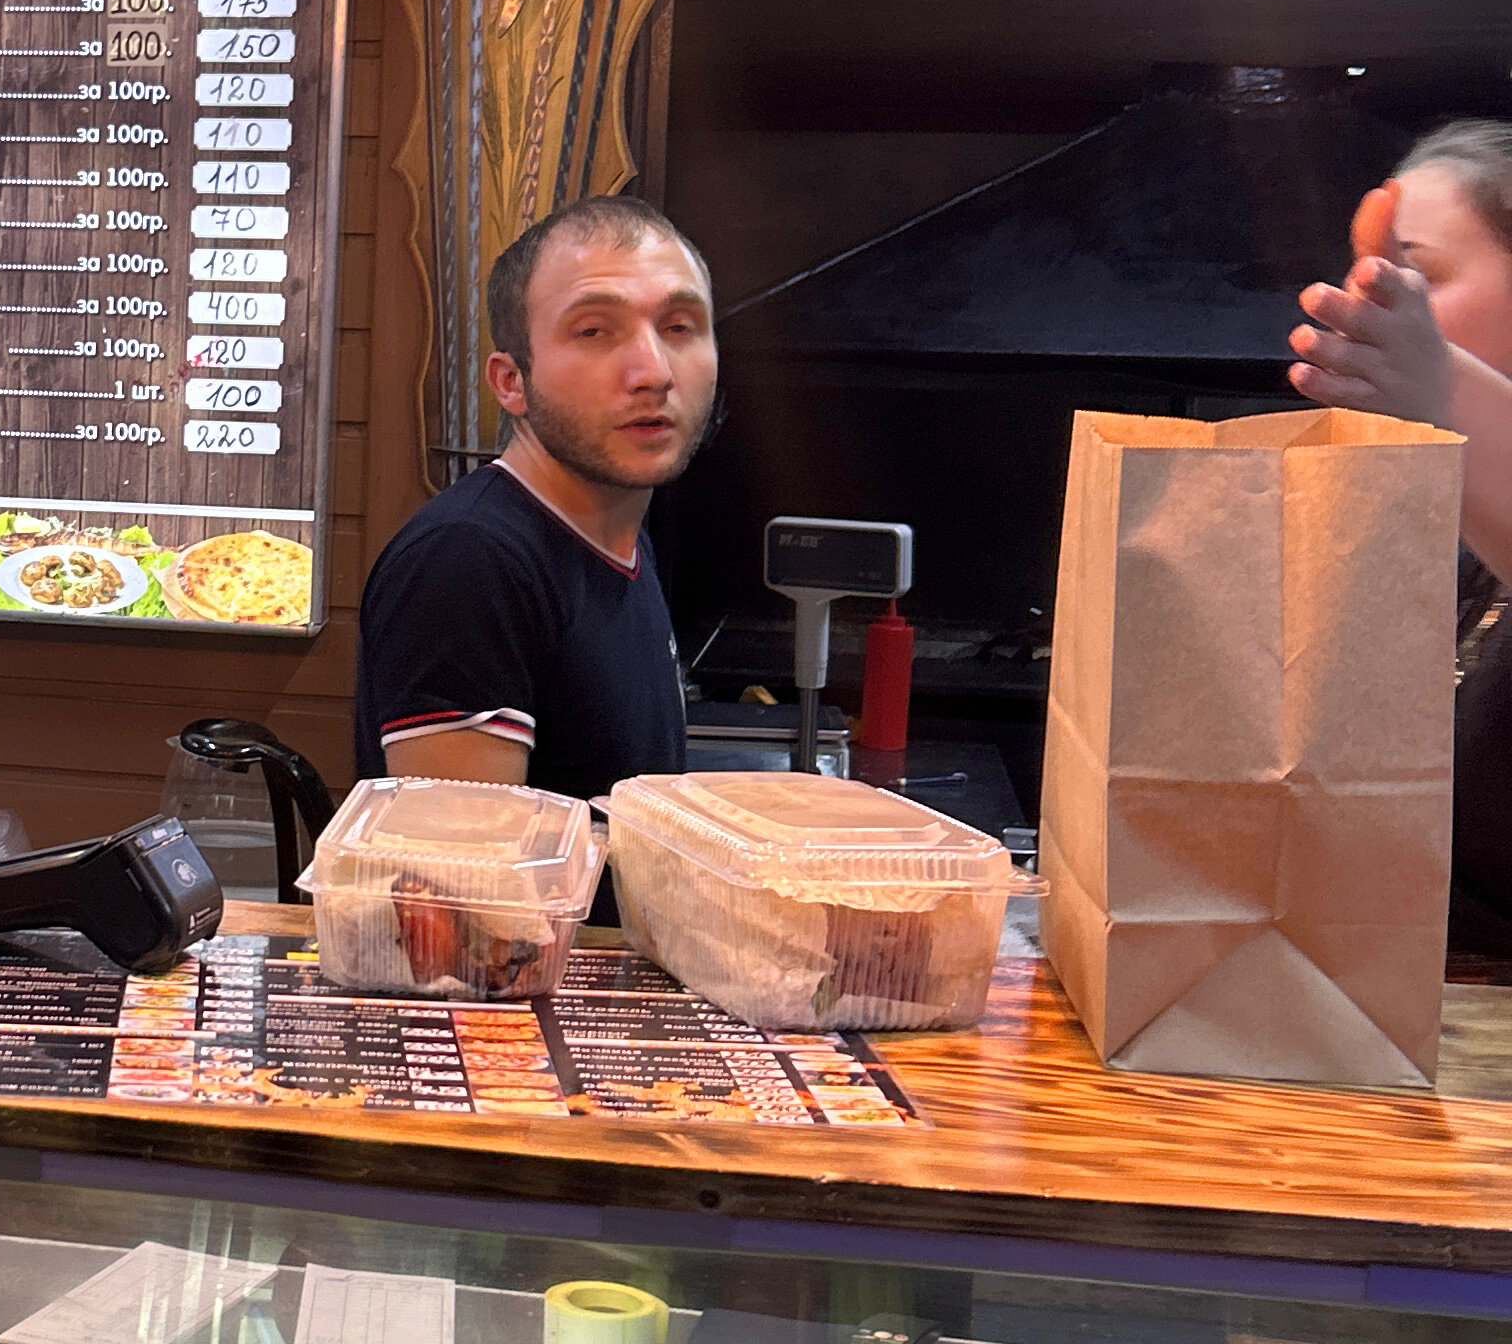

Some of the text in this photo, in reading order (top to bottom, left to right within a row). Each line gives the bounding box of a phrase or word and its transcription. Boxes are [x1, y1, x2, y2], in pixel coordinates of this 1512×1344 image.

[219, 33, 280, 60] 150
[210, 76, 265, 103] 120
[209, 122, 262, 147] 110
[208, 164, 260, 192] 110
[211, 208, 256, 231] 70
[203, 250, 258, 277] 120
[208, 293, 258, 320] 400
[203, 339, 246, 364] 120
[115, 381, 125, 398] 1
[132, 385, 164, 400] шт.
[206, 384, 261, 408] 100
[197, 425, 254, 448] 220
